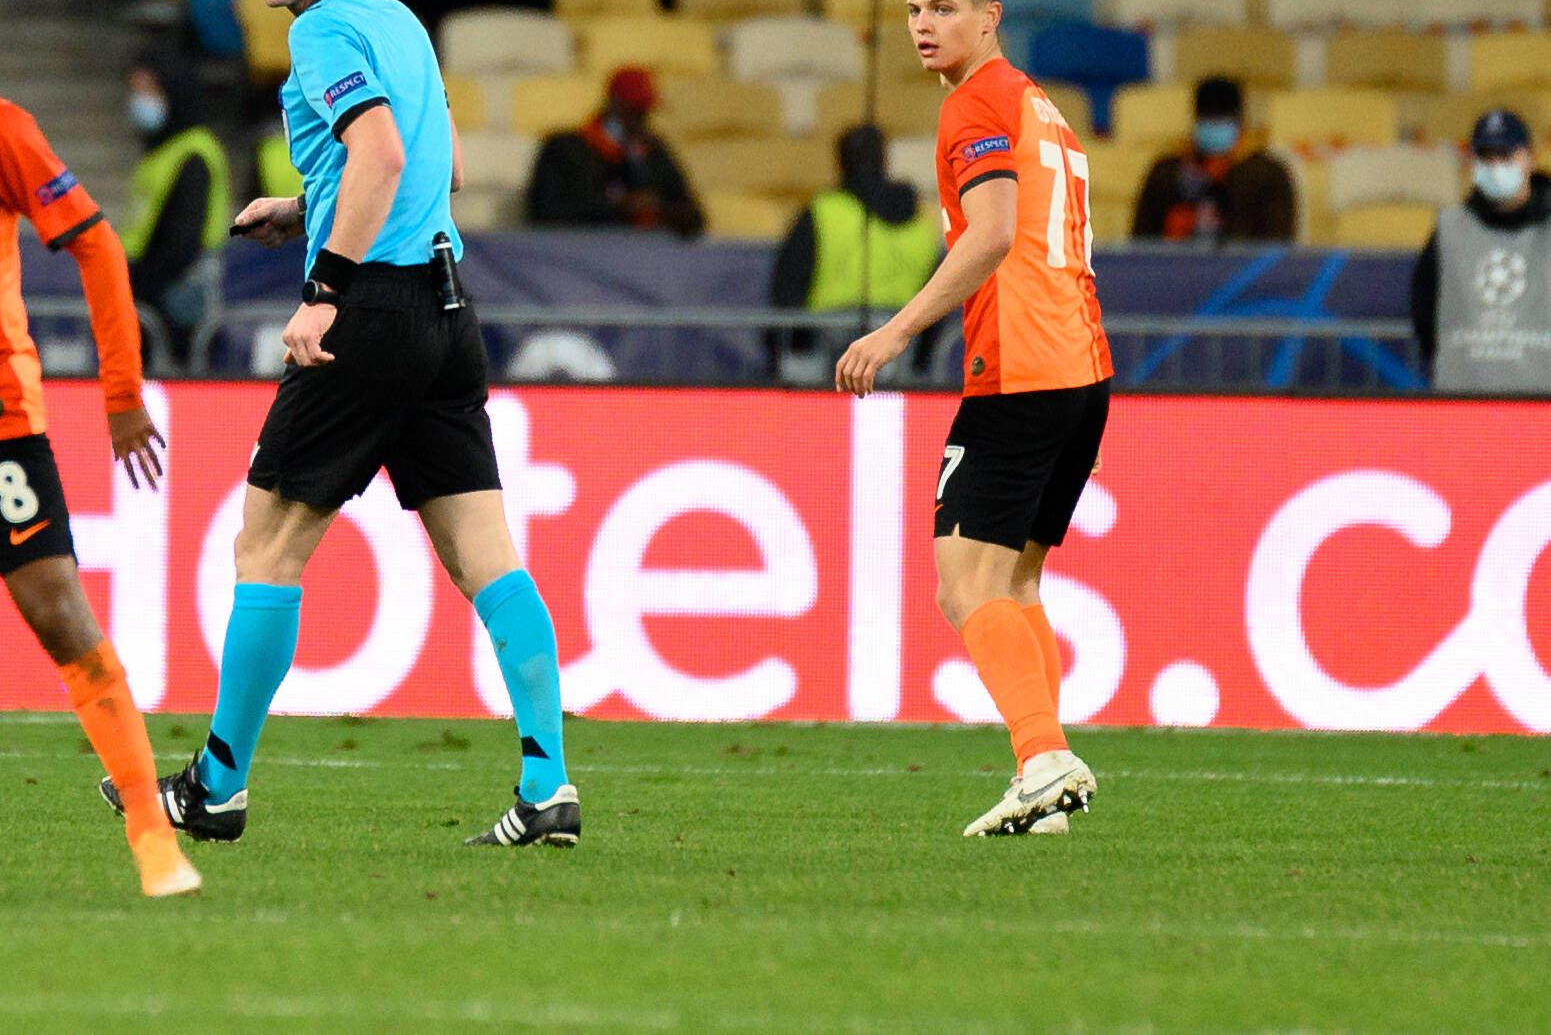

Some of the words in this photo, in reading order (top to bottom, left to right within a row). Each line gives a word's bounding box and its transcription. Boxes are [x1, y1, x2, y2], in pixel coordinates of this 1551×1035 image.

[330, 74, 365, 98] RESPECT
[974, 139, 1009, 152] RESPECT
[1038, 139, 1096, 277] 77
